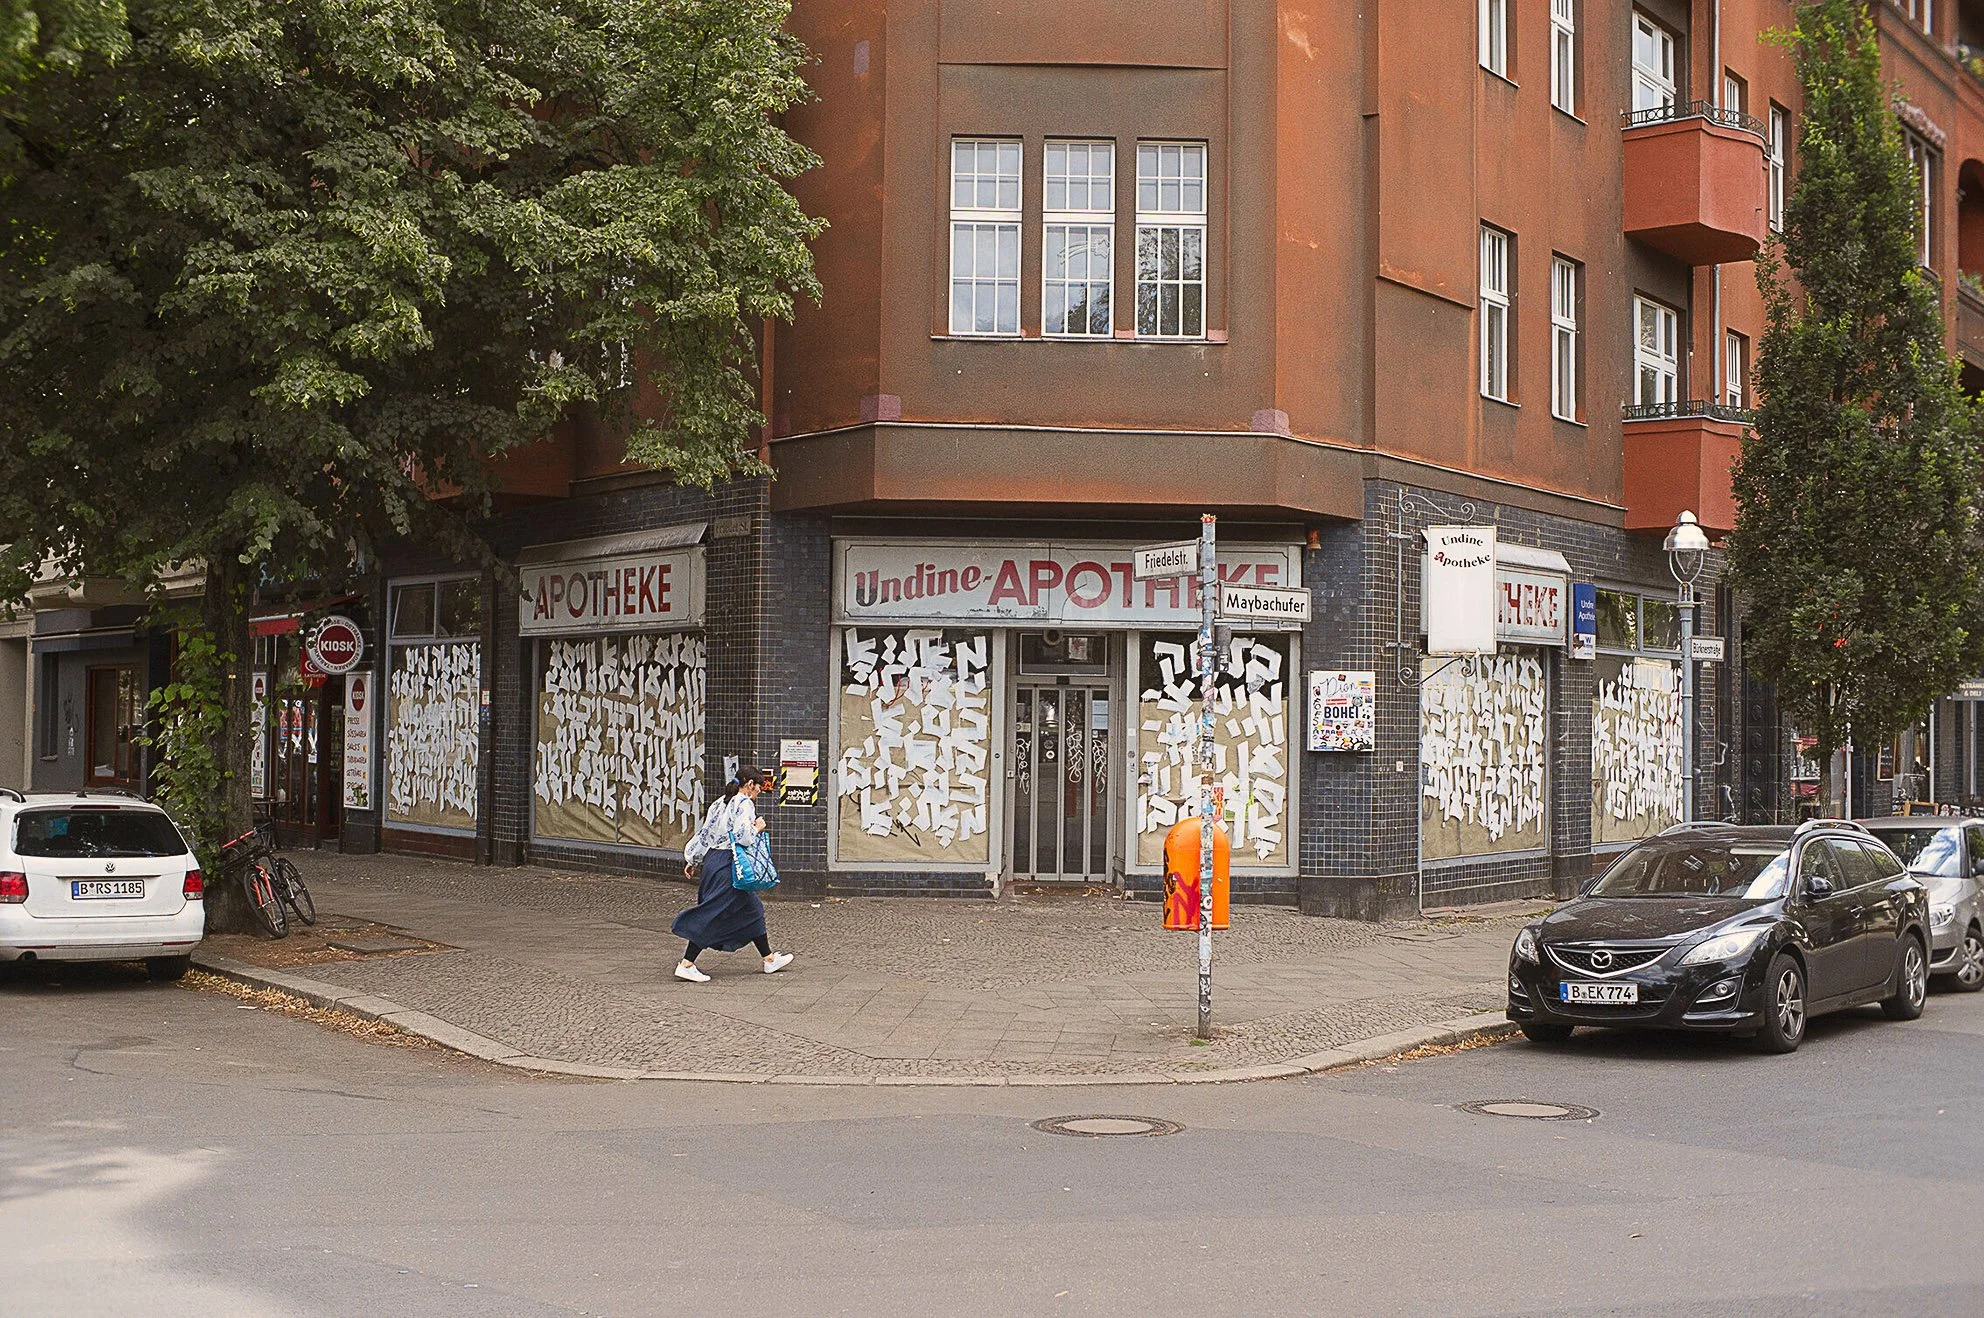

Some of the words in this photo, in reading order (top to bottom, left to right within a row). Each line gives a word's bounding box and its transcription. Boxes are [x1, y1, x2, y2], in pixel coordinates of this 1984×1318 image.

[1441, 534, 1483, 546] Undine
[1145, 551, 1189, 569] Friedelstr.
[1434, 551, 1491, 568] Apotheke
[534, 564, 672, 620] APOTHEKE
[1226, 593, 1305, 613] Maybachufer
[320, 640, 354, 652] KIOSK
[1324, 706, 1359, 719] BOHEI
[114, 882, 142, 894] 1185
